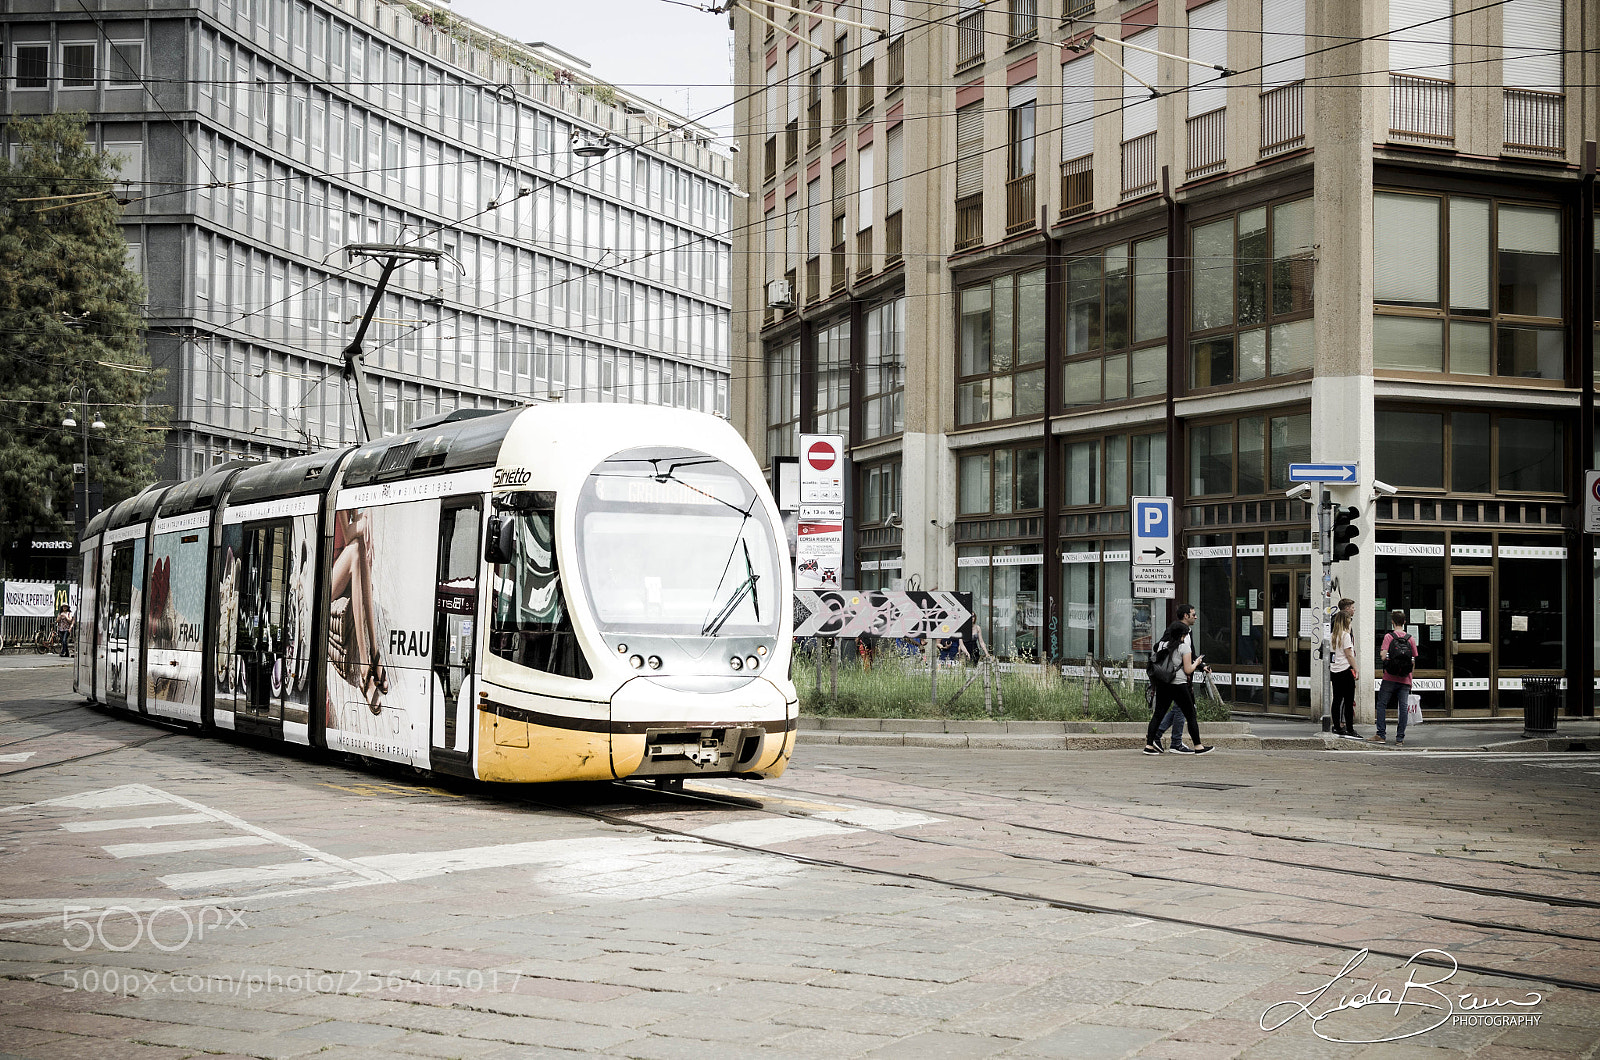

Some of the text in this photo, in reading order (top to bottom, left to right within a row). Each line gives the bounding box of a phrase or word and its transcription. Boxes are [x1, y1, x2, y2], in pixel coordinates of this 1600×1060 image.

[1144, 507, 1163, 533] P
[1374, 544, 1397, 553] INTESA
[6, 592, 54, 607] NUOVA APERTURA
[179, 623, 201, 643] FRAU
[389, 629, 431, 658] FRAU
[1411, 679, 1442, 689] ANPAOLO
[336, 735, 349, 746] INFO
